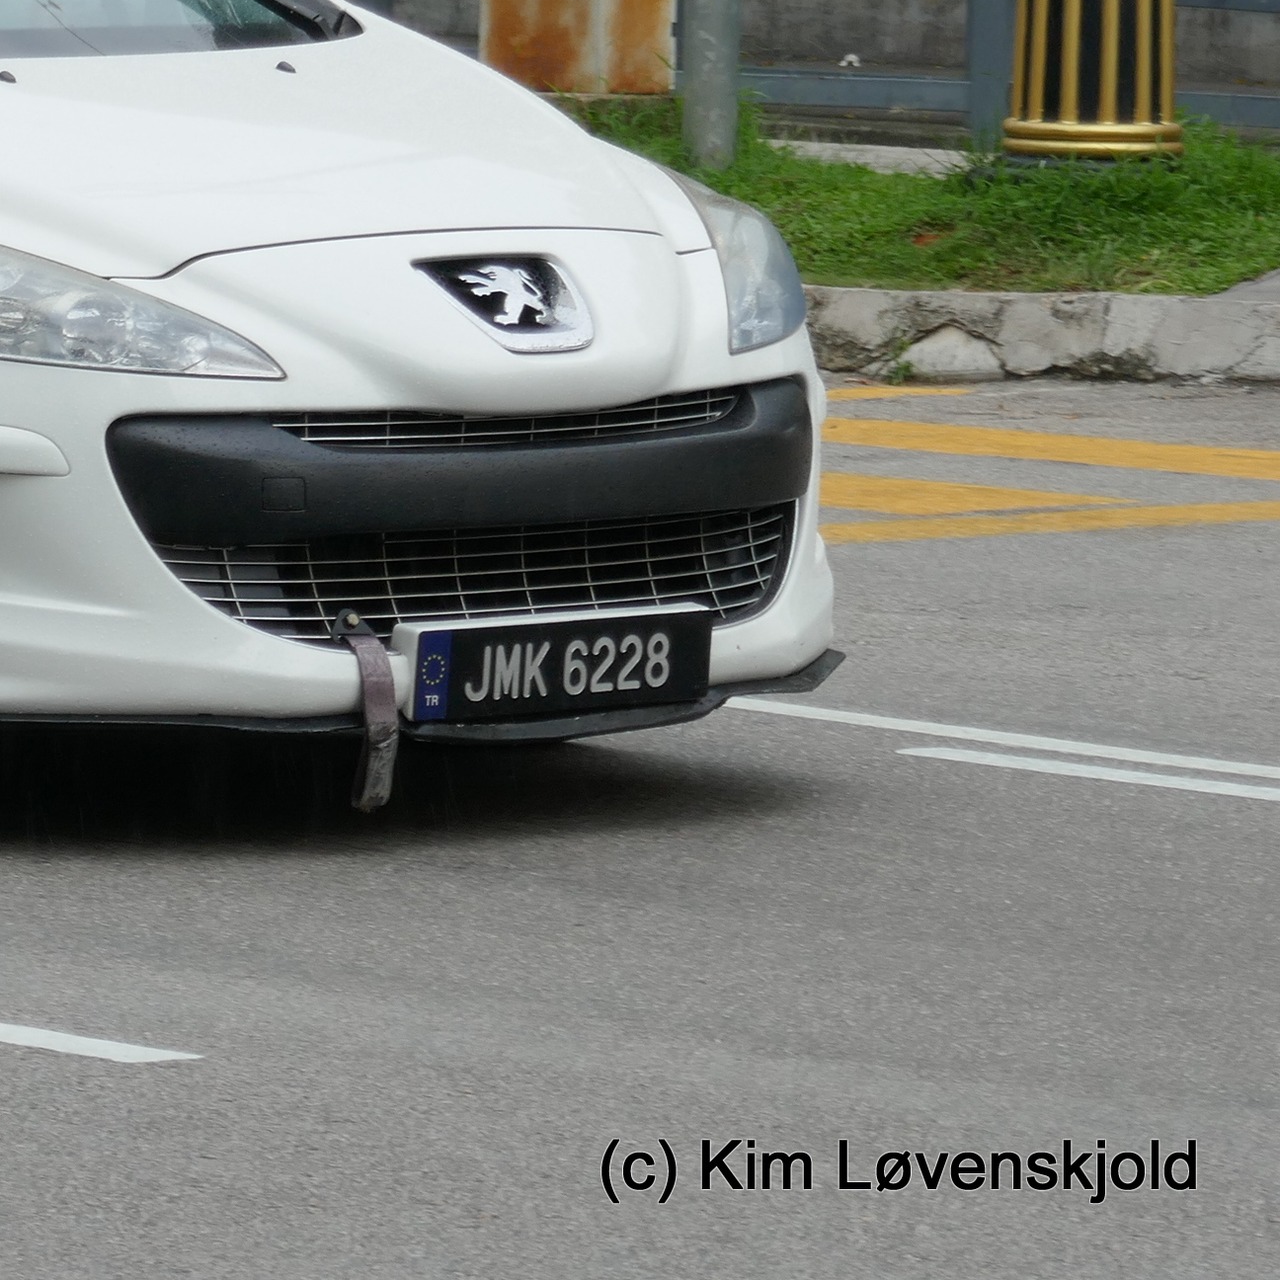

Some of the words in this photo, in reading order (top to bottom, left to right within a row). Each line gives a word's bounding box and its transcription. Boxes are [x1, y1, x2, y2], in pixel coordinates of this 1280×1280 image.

[464, 641, 551, 703] JMK
[563, 632, 670, 696] 6228
[425, 695, 439, 707] TR
